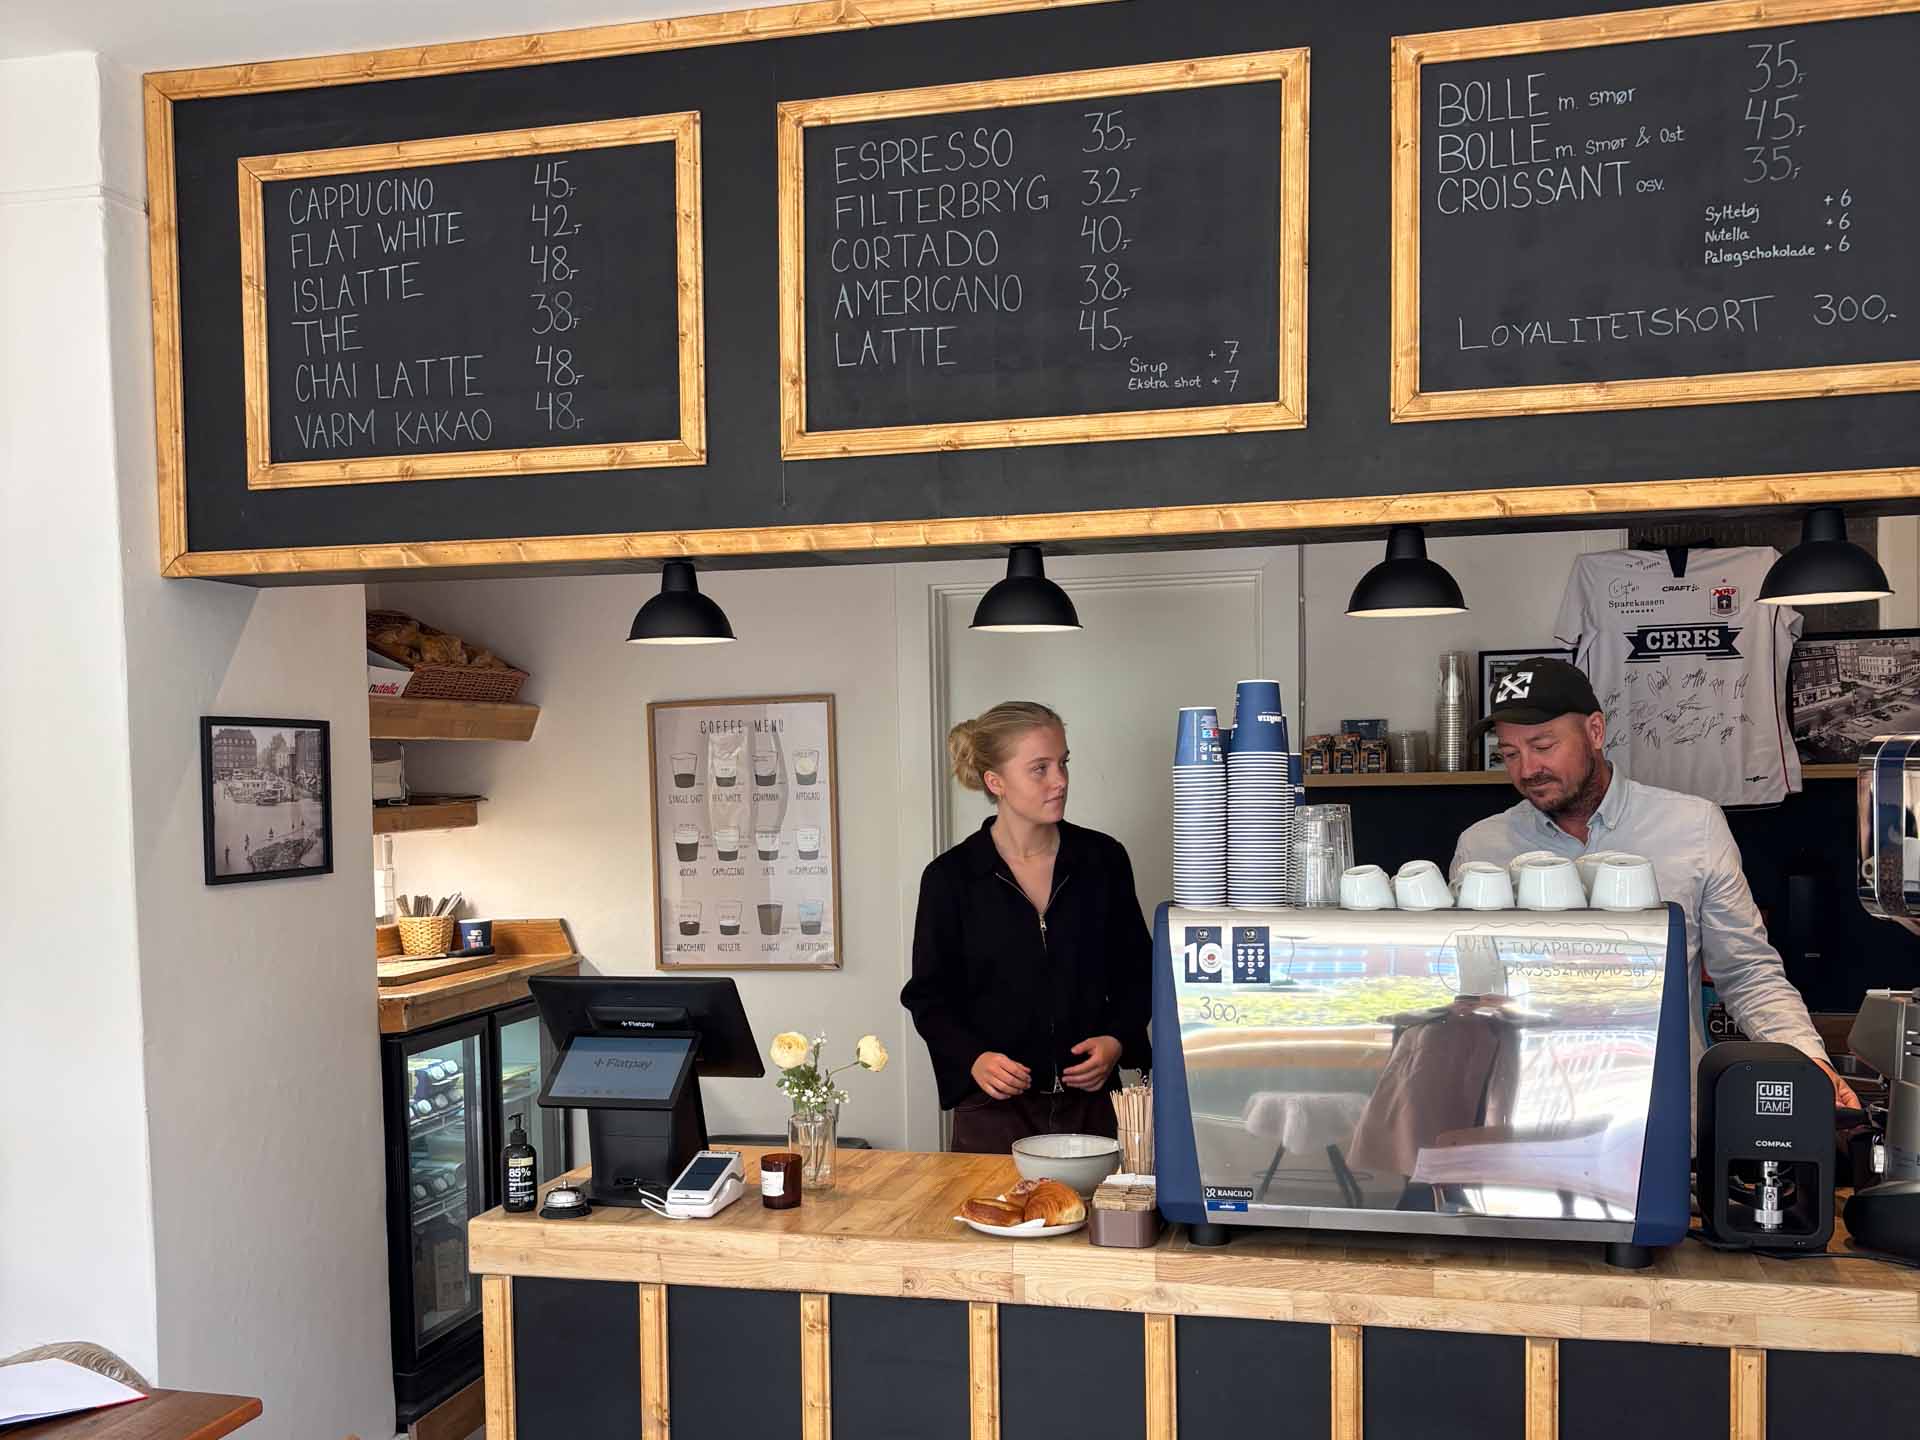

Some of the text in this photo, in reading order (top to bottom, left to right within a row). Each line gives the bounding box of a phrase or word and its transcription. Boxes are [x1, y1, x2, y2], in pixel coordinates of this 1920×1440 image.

[1437, 39, 1807, 127] BOLLE m. smør 35,-
[835, 109, 1137, 185] ESPRESSO 35,-
[1437, 122, 1552, 174] BOLLE
[1555, 142, 1577, 160] m.
[1585, 136, 1628, 157] smør
[1634, 125, 1651, 148] &
[1744, 94, 1807, 141] 45,-
[288, 160, 578, 225] CAPPUCINO 45,-
[835, 167, 1143, 231] FILTERBRYG 32,-
[1437, 145, 1802, 214] CROISSANT osv. 35,-
[1704, 188, 1852, 227] Syltetøj + 6
[1704, 226, 1751, 244] Nutella
[1838, 212, 1851, 231] 6
[291, 204, 583, 270] FLAT WHITE 42,-
[830, 215, 1133, 273] CORTADO 40,-
[1838, 234, 1851, 252] 6
[293, 245, 581, 313] ISLATTE 48,-
[834, 263, 1133, 320] AMERICANO 38,-
[292, 313, 365, 357] THE
[834, 307, 1134, 368] LATTE 45,-
[1458, 293, 1898, 350] LOYALITETSKORT 300,-
[295, 344, 585, 403] CHAI LATTE 48,-
[1127, 369, 1240, 394] Ekstra shot + 7
[1129, 339, 1240, 379] Sirup + 7
[293, 391, 585, 449] VARM KAKAO 48,-
[1661, 585, 1692, 593] CRAFT
[1645, 629, 1722, 650] CERES
[368, 682, 400, 695] nutella
[700, 718, 785, 734] COFFEE MENU
[1758, 1084, 1791, 1097] CUBE
[1759, 1101, 1791, 1112] TAMP
[1755, 1139, 1793, 1149] COMPAK
[508, 1167, 532, 1177] 85%
